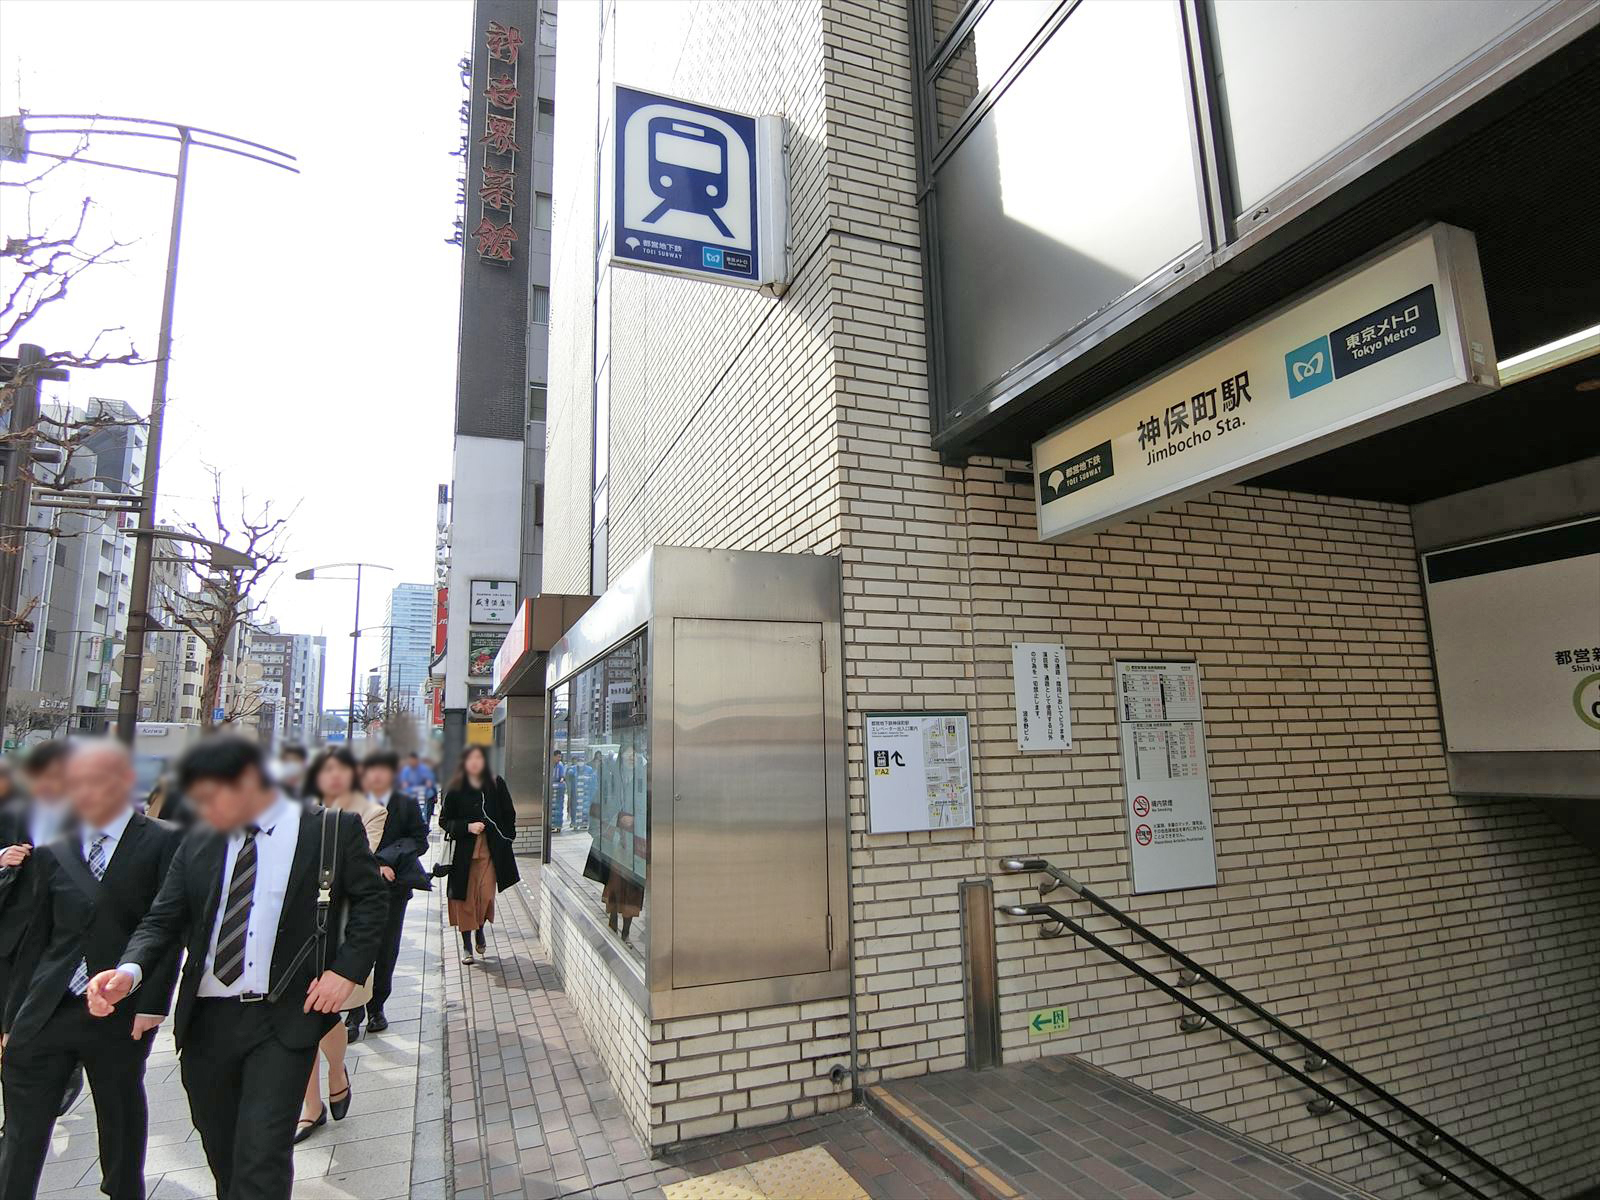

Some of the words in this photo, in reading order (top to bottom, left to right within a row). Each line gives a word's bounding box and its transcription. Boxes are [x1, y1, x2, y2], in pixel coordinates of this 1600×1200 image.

[470, 20, 524, 260] 新世界菜館
[643, 240, 682, 252] 都営地下鉄
[658, 250, 682, 260] SUBWAY
[1345, 304, 1420, 351] 東京メトロ
[1351, 339, 1383, 360] Tokyo
[1383, 325, 1417, 349] Metro
[1137, 371, 1252, 451] 神保町駅
[1147, 429, 1211, 466] Jimbocho
[1217, 417, 1246, 438] Sta.
[1065, 454, 1101, 478] 都営地下鉄
[1066, 474, 1080, 487] TOEI
[1080, 465, 1102, 484] SUBWAY
